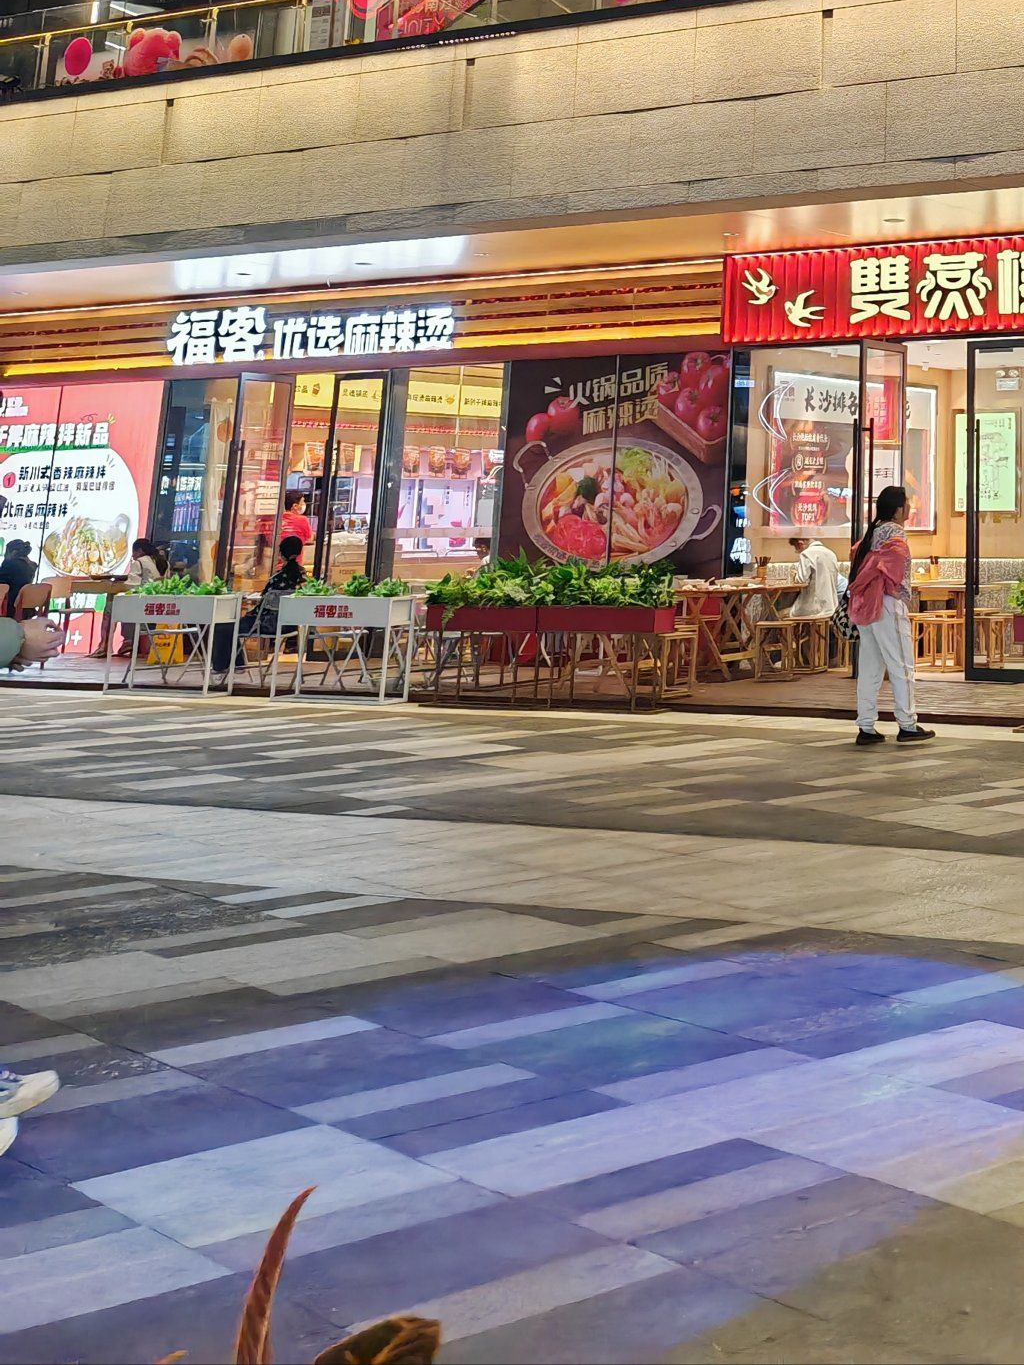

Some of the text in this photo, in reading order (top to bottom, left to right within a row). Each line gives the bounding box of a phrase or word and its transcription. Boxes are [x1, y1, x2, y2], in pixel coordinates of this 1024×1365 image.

[166, 306, 267, 365] 福客
[568, 362, 679, 409] 火锅品质
